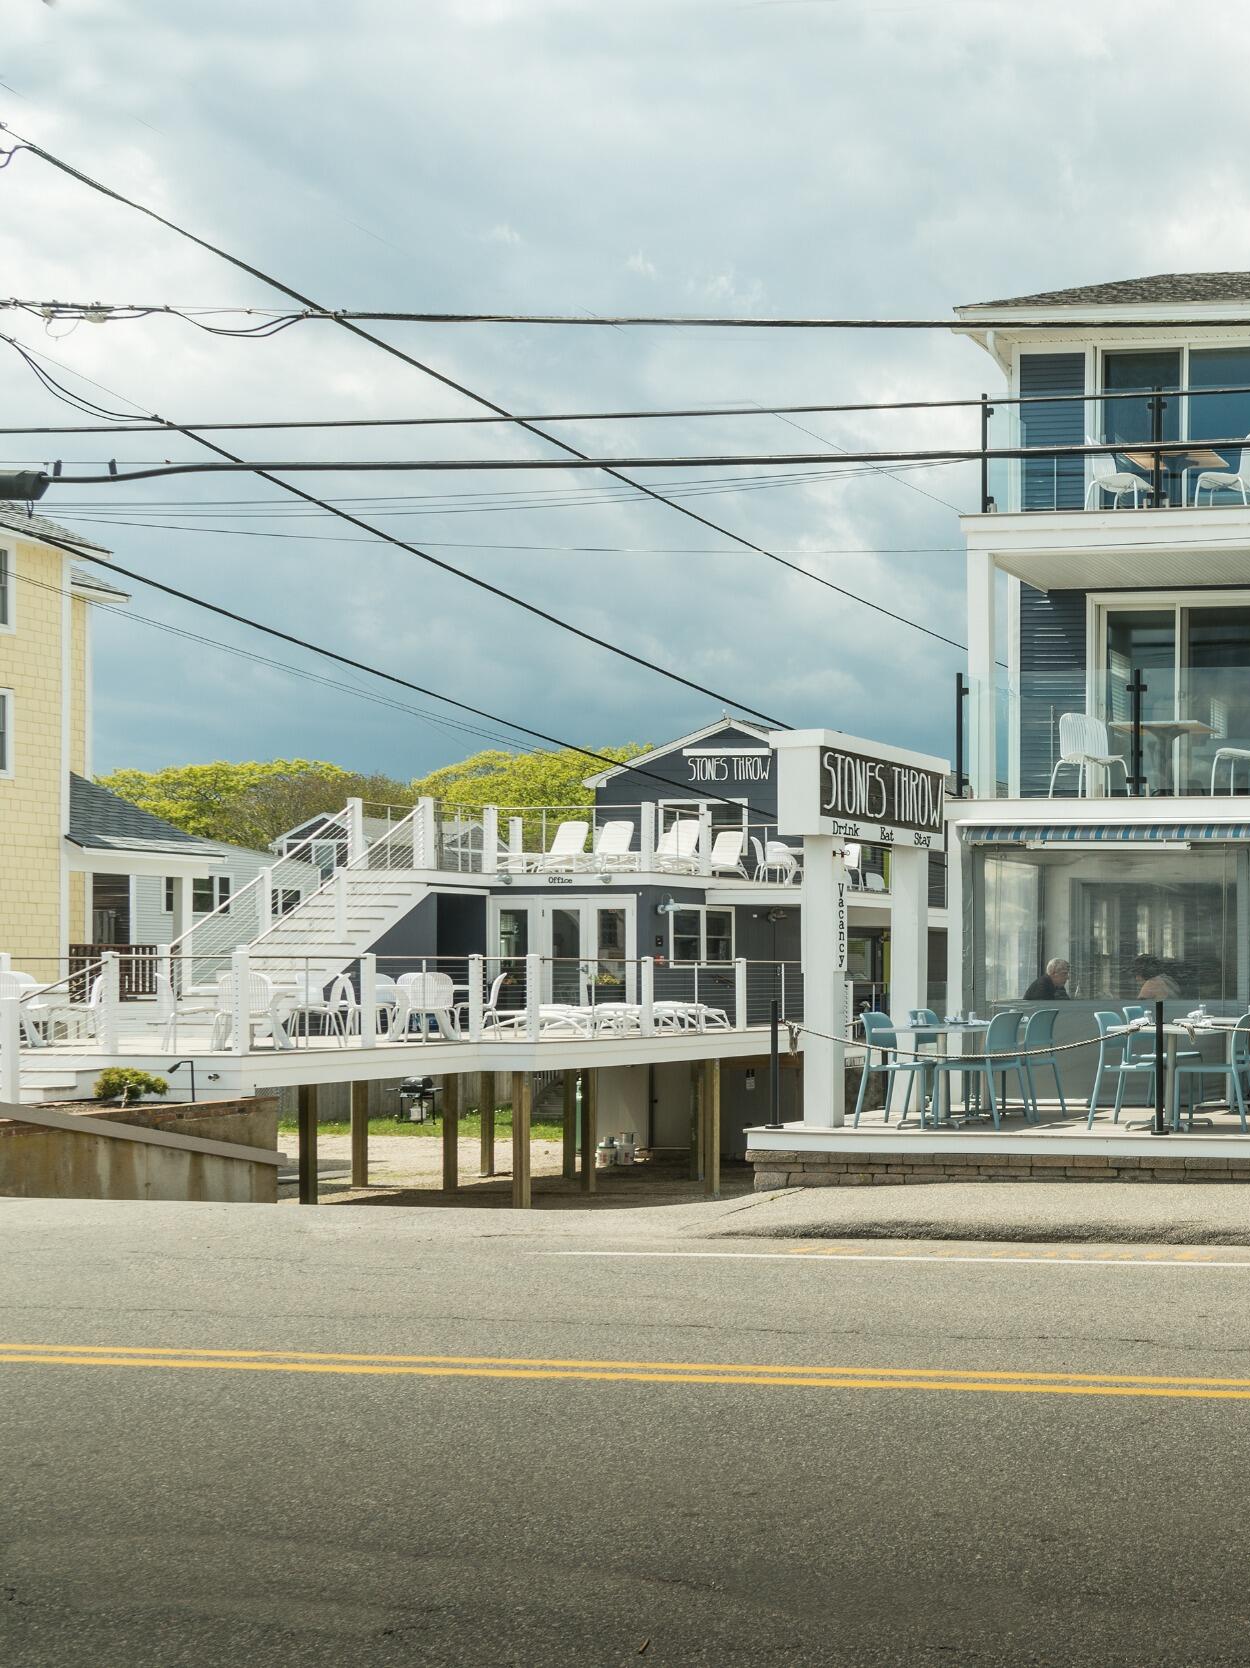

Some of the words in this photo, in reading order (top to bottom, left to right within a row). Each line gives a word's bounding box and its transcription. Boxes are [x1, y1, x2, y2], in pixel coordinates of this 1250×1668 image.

[687, 757, 728, 781] STONES
[731, 757, 771, 780] THROW
[823, 751, 887, 819] STONES
[892, 767, 943, 828] THROW
[832, 820, 860, 837] Drink
[880, 827, 895, 842] Eat
[913, 832, 932, 848] Stay
[548, 876, 573, 884] Office
[837, 882, 845, 968] Vacancy
